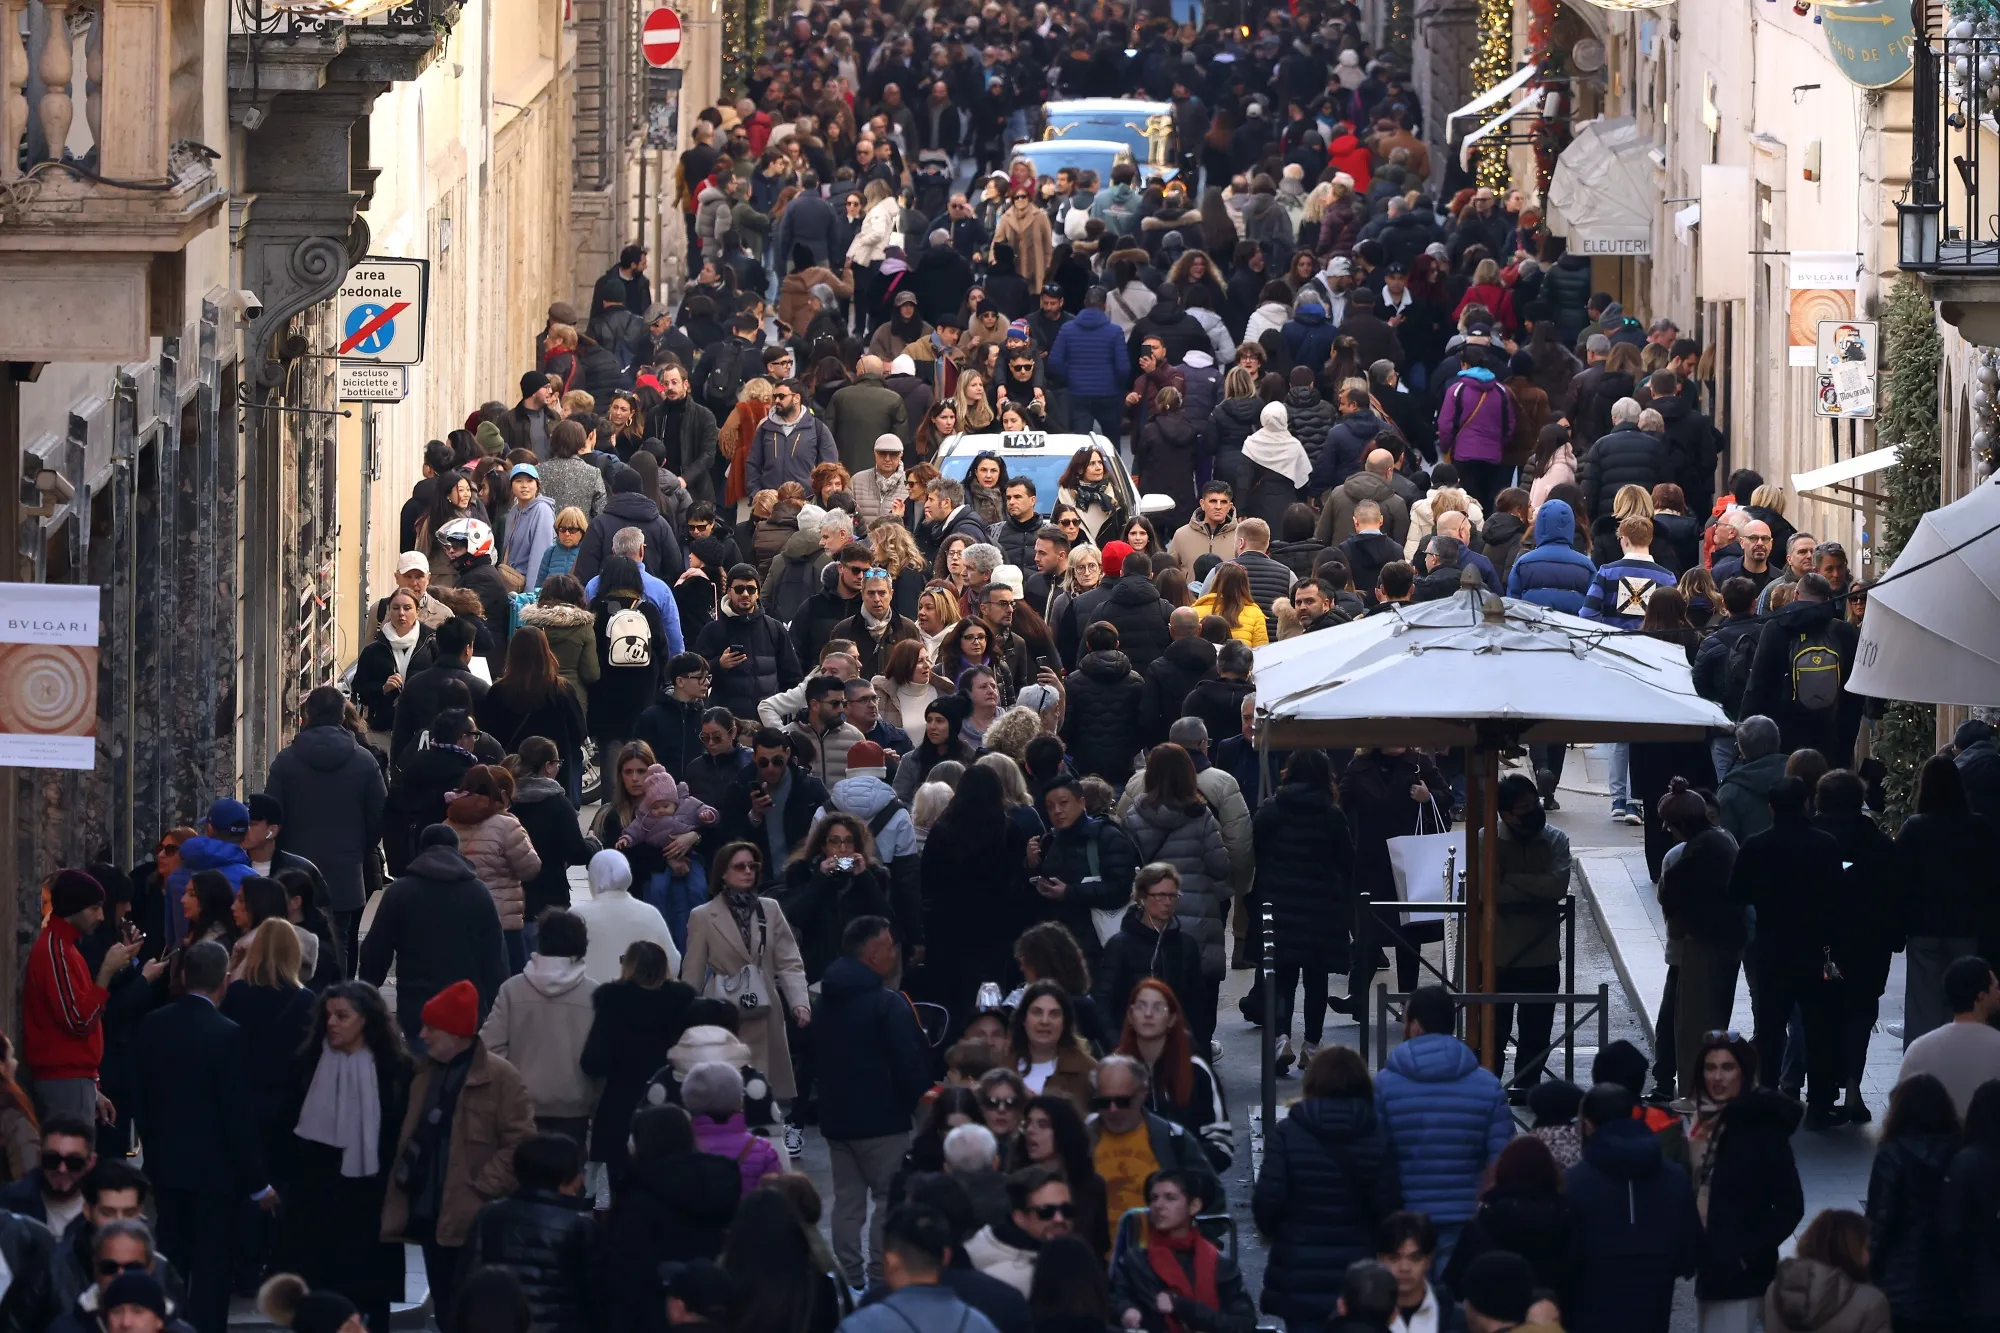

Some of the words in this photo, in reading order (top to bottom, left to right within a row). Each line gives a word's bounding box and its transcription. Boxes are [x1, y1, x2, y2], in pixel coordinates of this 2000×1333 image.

[1861, 48, 1879, 62] DE
[1887, 27, 1916, 57] FIO
[1583, 239, 1646, 253] ELEUTERI
[355, 271, 386, 281] area
[352, 369, 389, 377] escluso
[343, 378, 389, 387] biciclette
[1007, 434, 1040, 447] TAXI
[8, 619, 87, 632] BVLGARI
